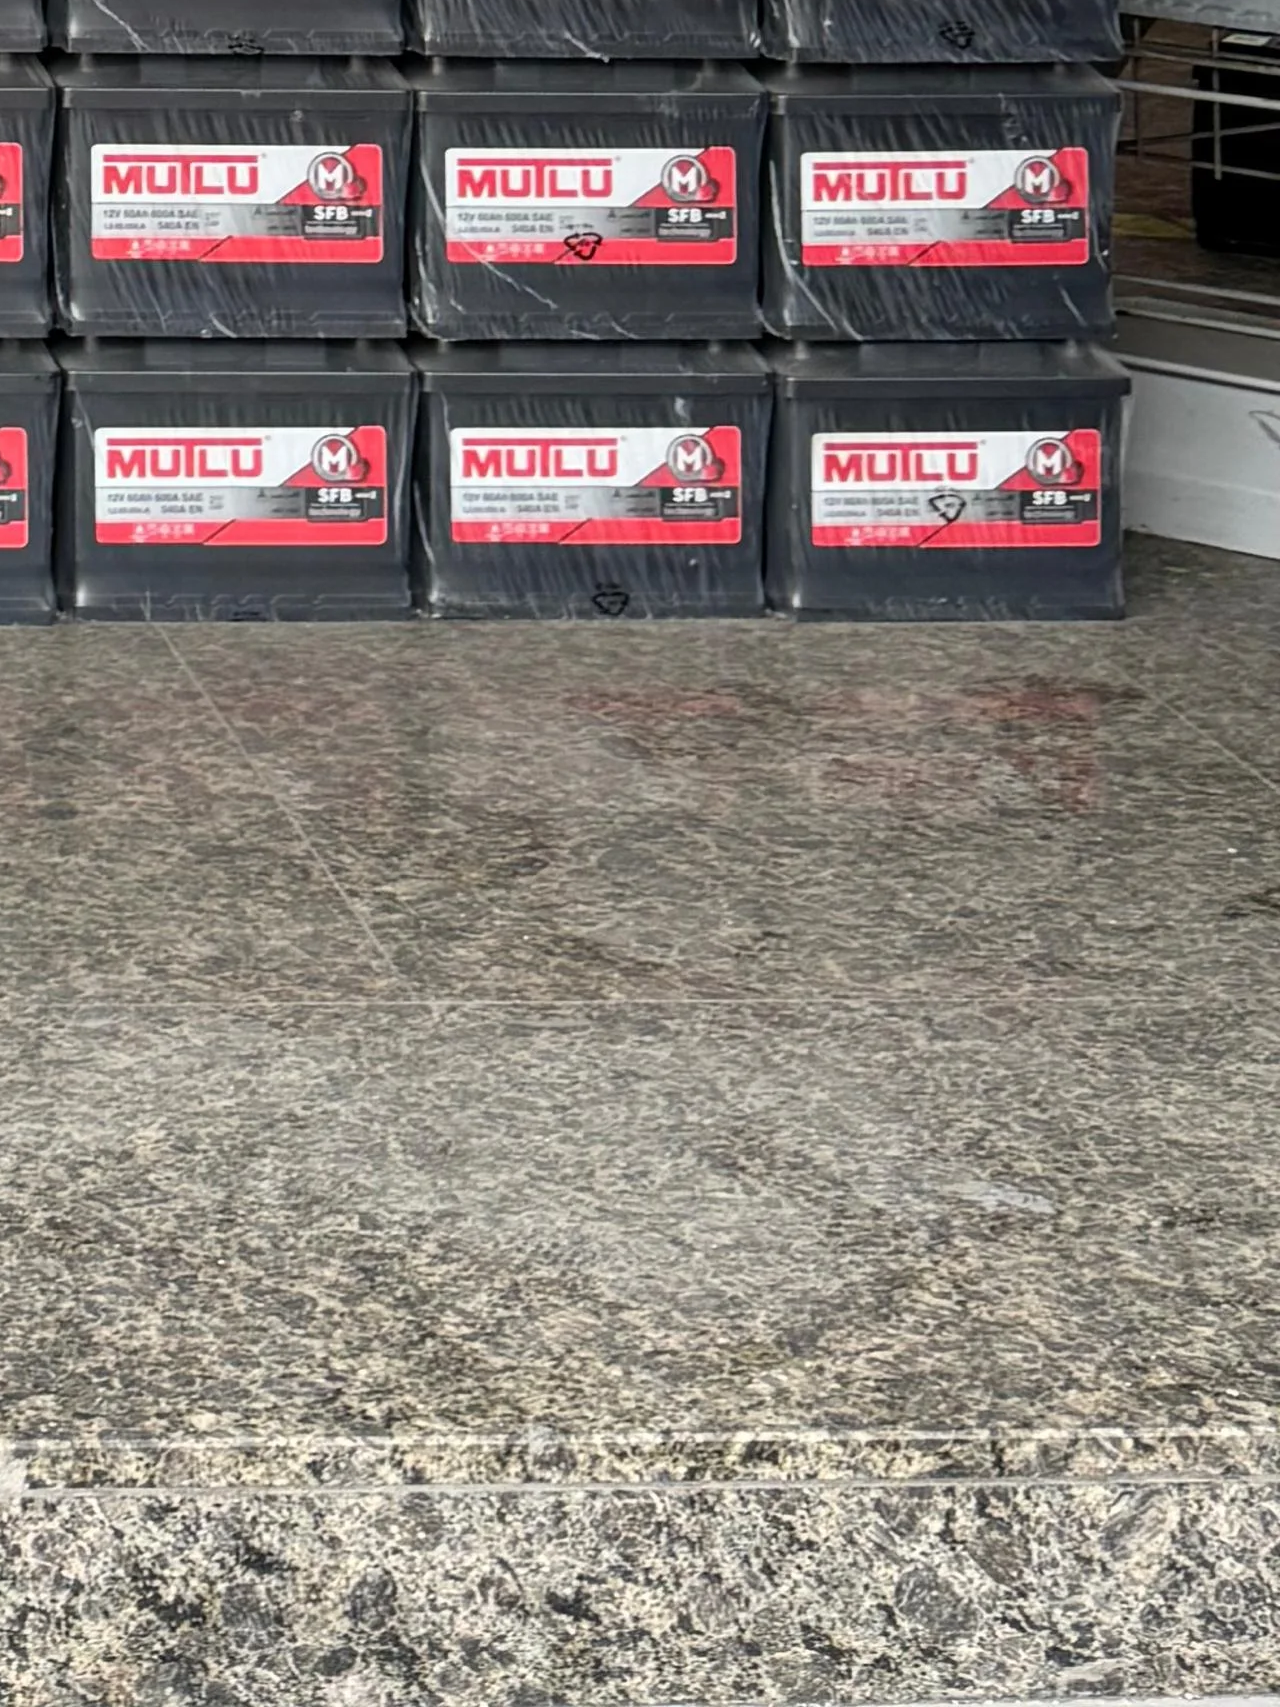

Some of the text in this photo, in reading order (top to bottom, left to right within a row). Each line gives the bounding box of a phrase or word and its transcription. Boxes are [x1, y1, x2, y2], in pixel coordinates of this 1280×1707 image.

[103, 155, 258, 195] MUTLU
[457, 158, 612, 198] MUTLU
[813, 161, 967, 201] MUTLU
[313, 206, 349, 220] SFB
[667, 209, 703, 222] SFB
[1021, 210, 1055, 223] SFB
[107, 438, 262, 478] MUTLU
[462, 438, 617, 478] MUTLU
[824, 442, 977, 482] MUTLU
[318, 488, 353, 502] SFB
[672, 488, 708, 502] SFB
[1032, 491, 1067, 505] SFB
